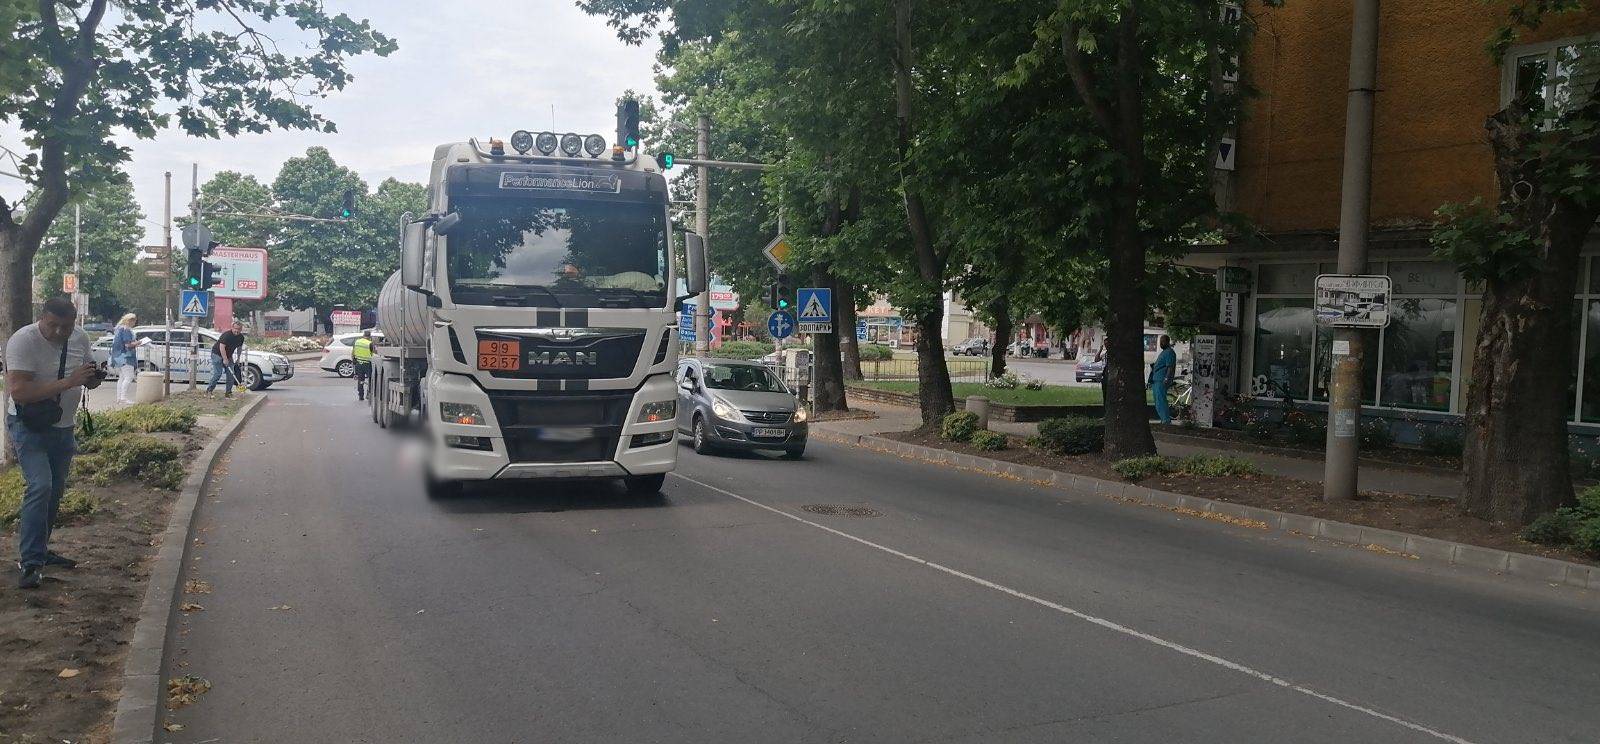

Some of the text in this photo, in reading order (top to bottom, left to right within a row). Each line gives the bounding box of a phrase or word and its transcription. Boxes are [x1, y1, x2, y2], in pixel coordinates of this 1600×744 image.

[665, 154, 672, 167] 9
[800, 323, 827, 331] ЗООПАРК
[490, 342, 509, 354] 99
[481, 356, 518, 368] 3257
[528, 351, 597, 365] MAN
